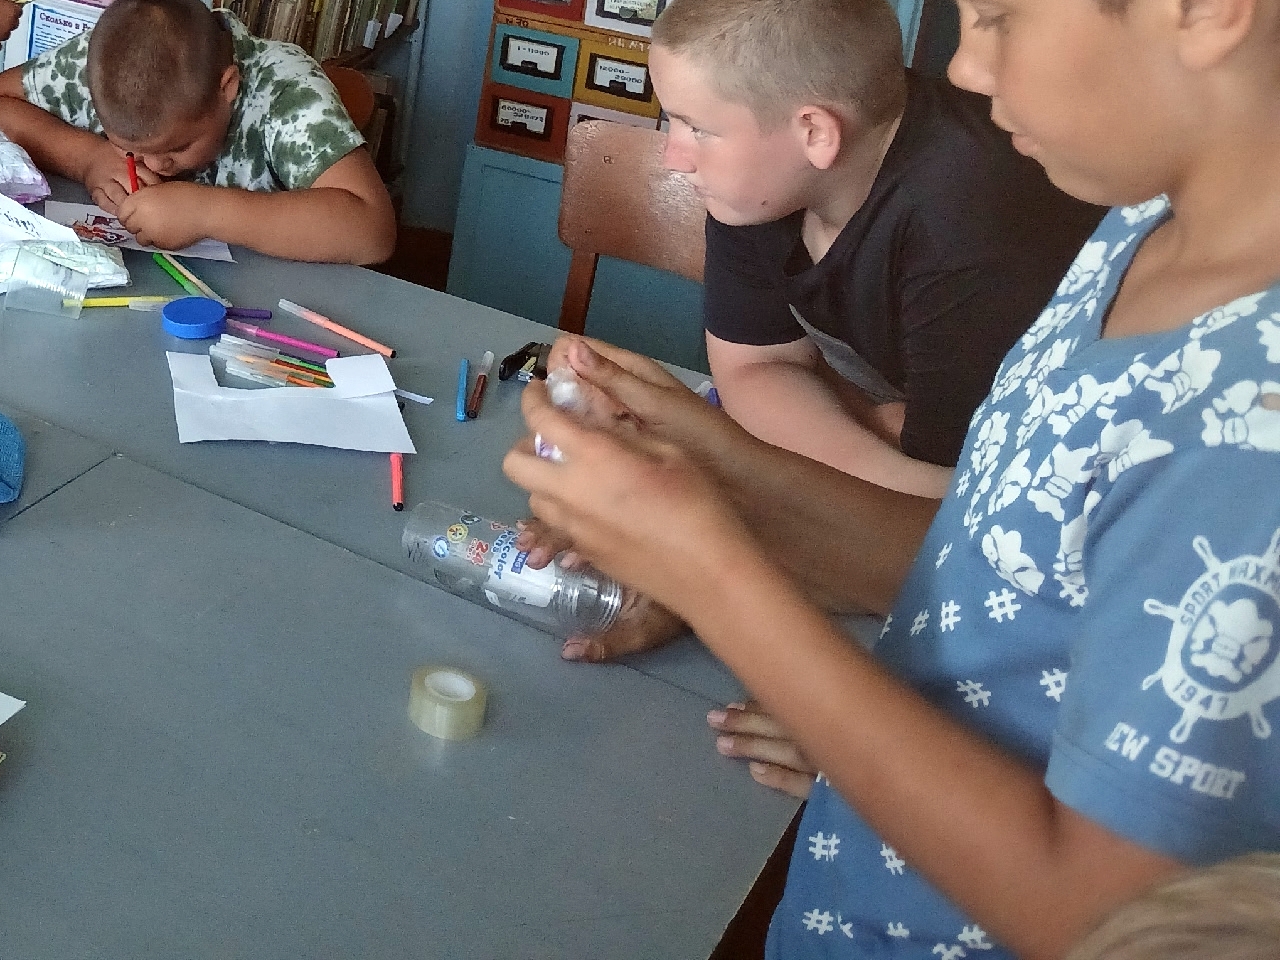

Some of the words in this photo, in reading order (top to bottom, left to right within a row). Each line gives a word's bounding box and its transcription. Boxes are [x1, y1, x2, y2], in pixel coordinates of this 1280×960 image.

[39, 12, 74, 29] Сколько
[1172, 678, 1230, 714] 1947
[1149, 744, 1247, 801] SPORT
